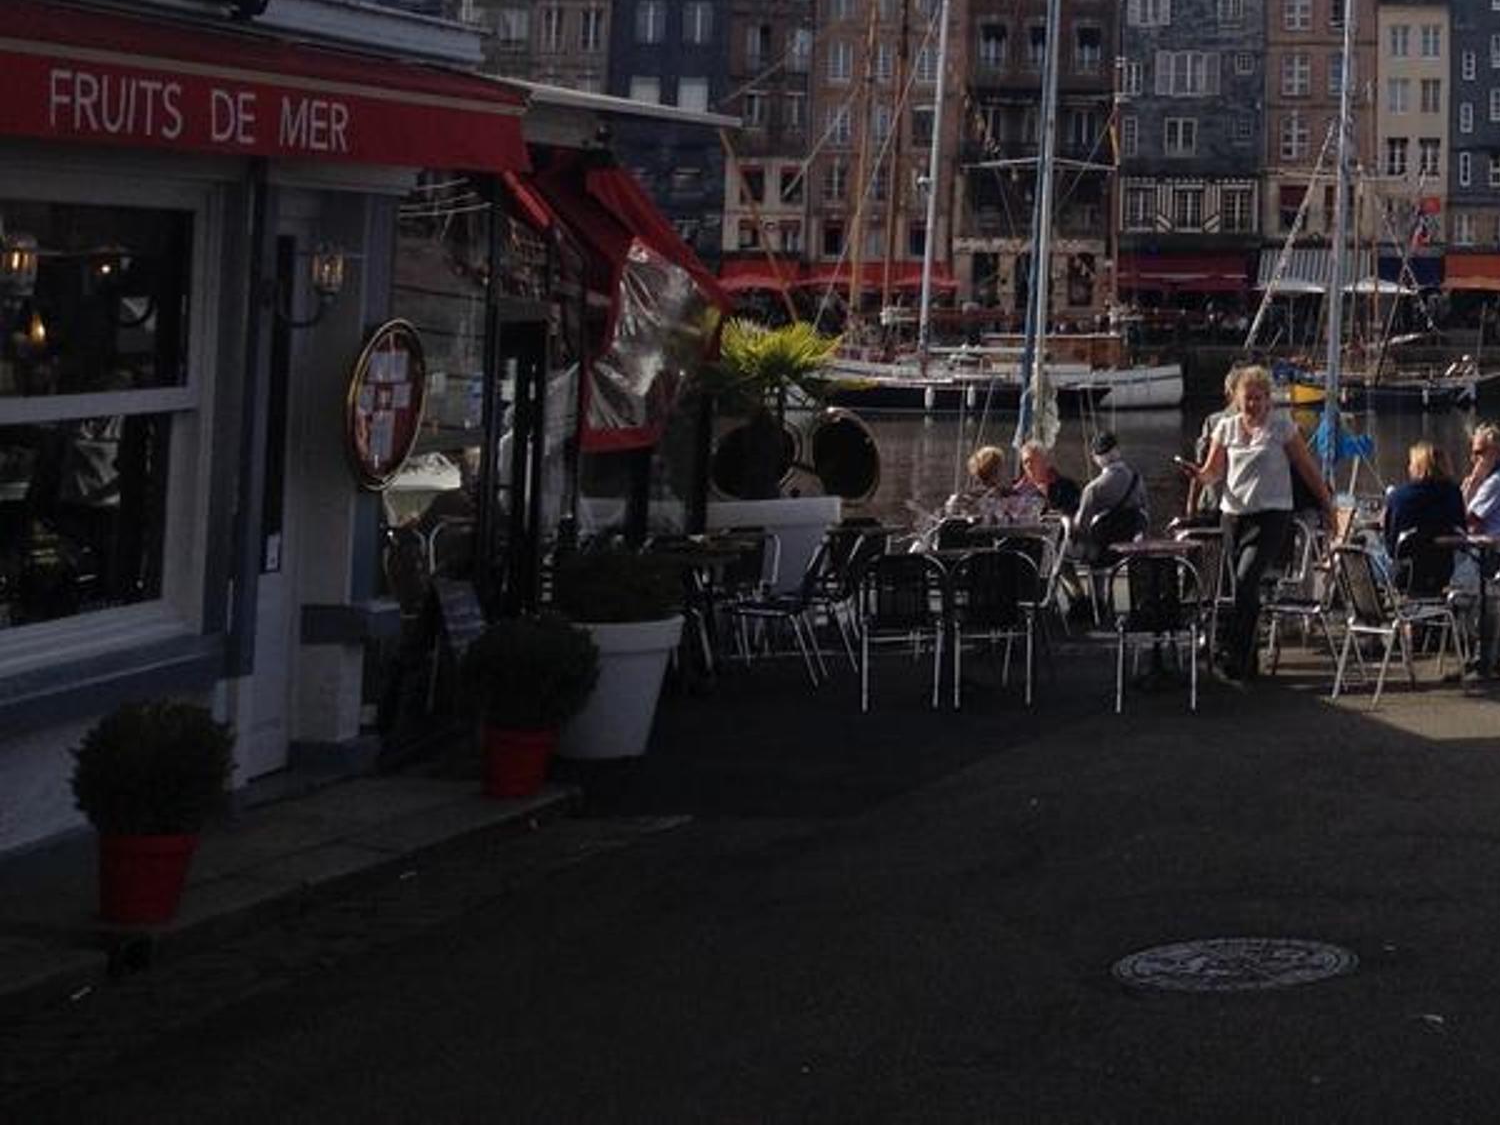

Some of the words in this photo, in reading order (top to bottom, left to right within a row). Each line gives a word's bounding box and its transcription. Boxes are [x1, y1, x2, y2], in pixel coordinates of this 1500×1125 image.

[50, 69, 183, 140] FRUITS
[211, 89, 256, 144] DE
[279, 96, 349, 152] MER
